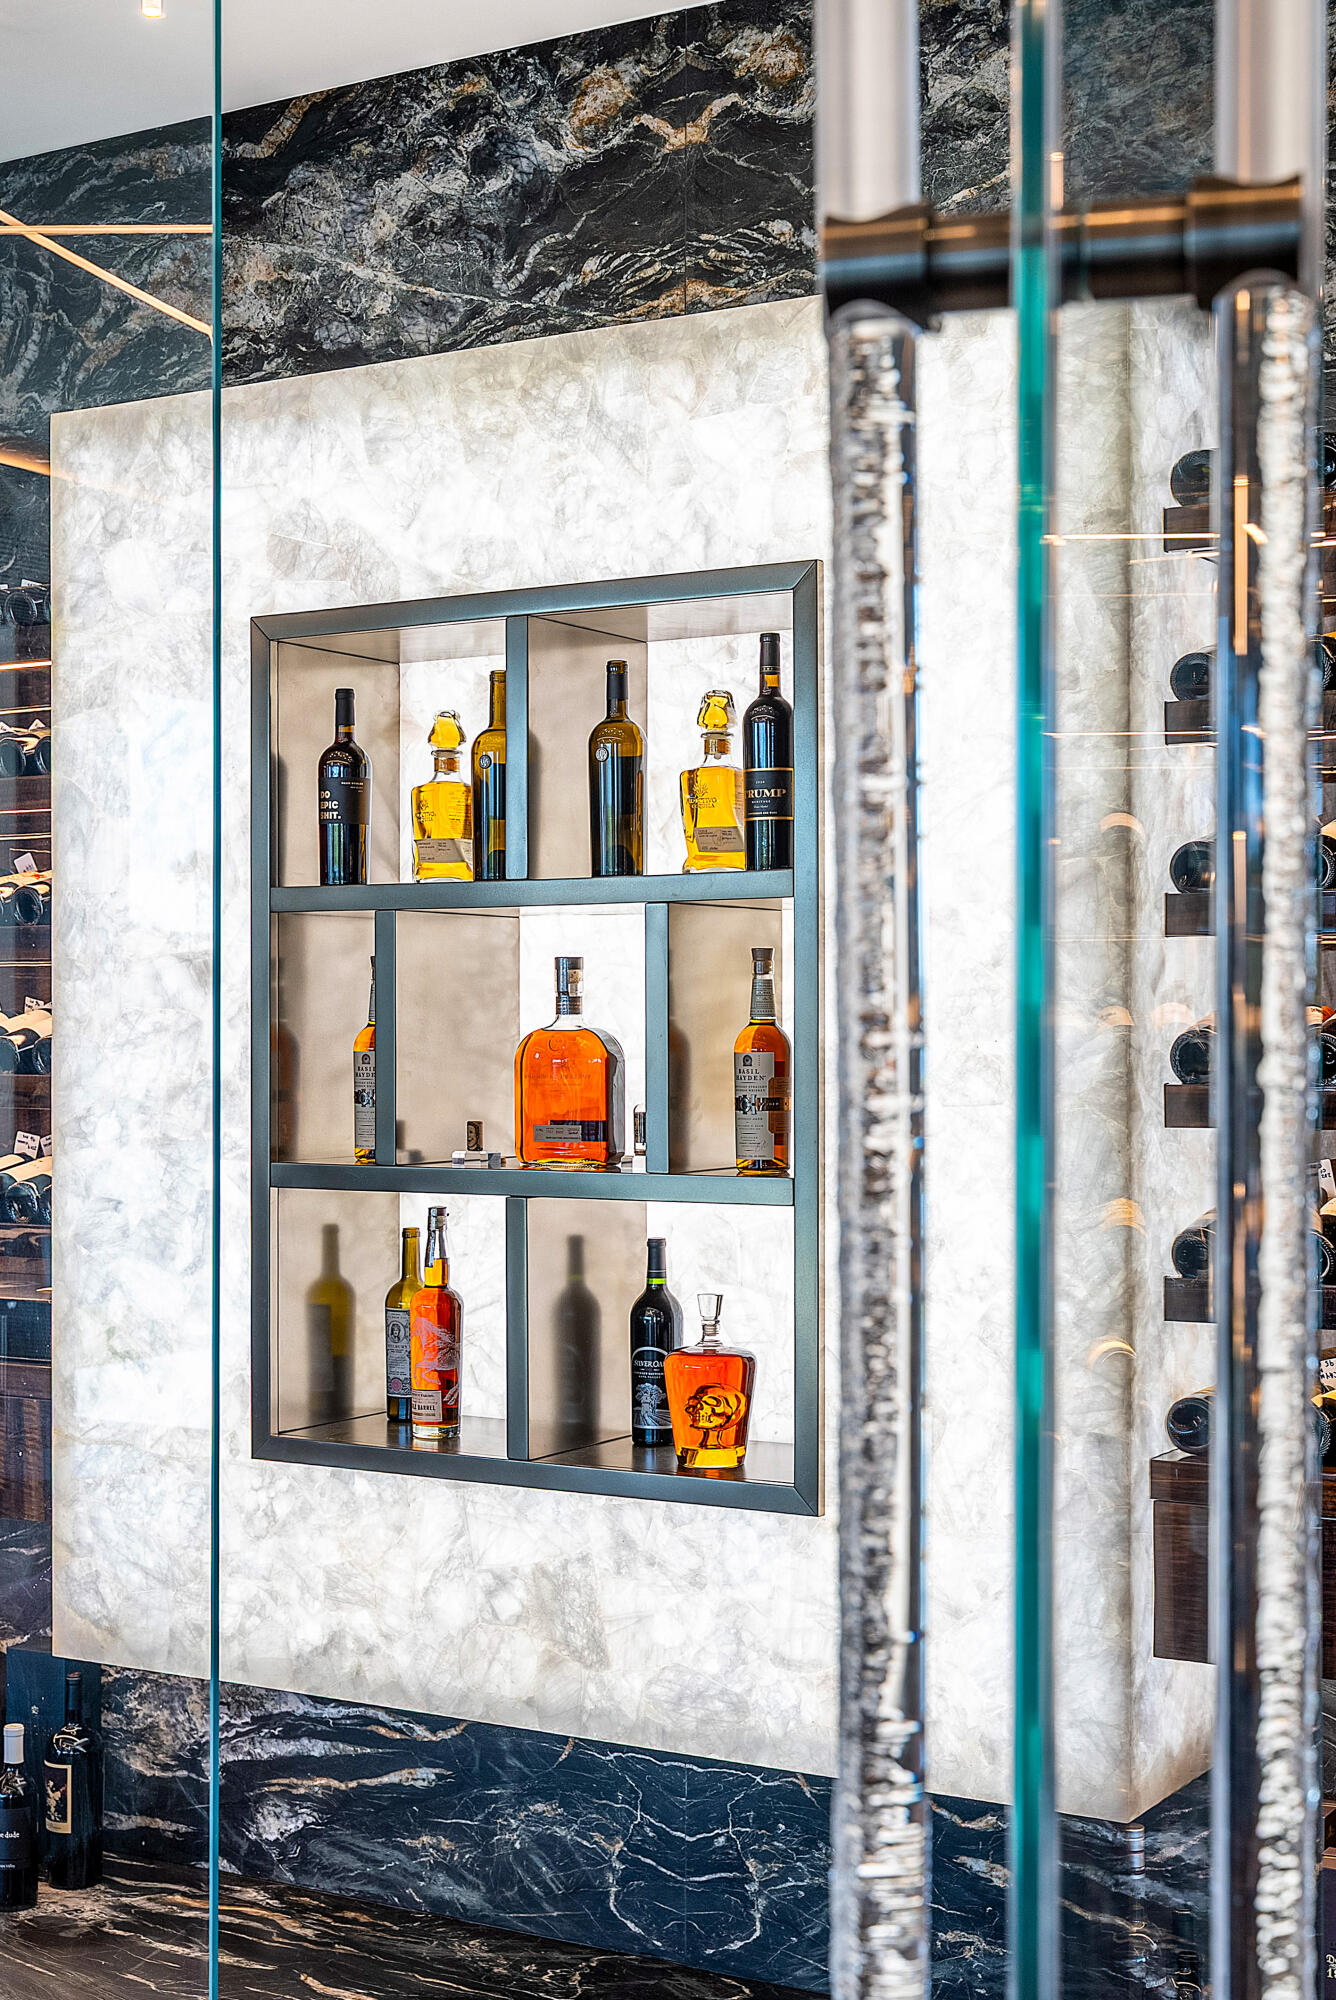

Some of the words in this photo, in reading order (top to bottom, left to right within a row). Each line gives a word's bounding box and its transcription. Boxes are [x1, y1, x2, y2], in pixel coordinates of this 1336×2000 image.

[320, 790, 331, 799] DO
[320, 800, 339, 809] EPIC
[320, 811, 342, 820] SHIT.
[4, 1831, 20, 1839] dude
